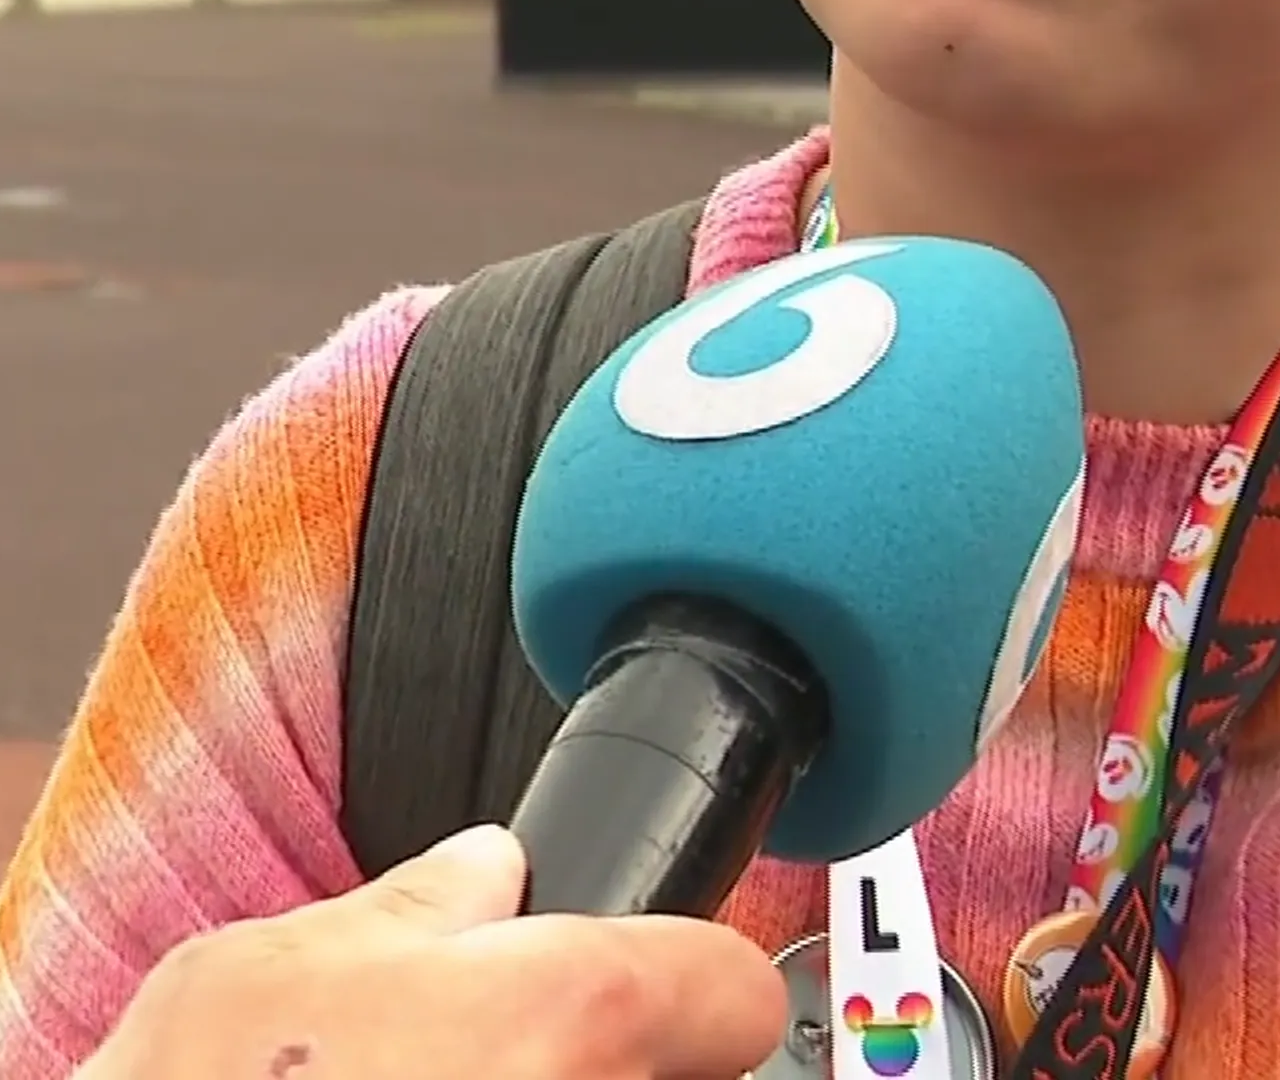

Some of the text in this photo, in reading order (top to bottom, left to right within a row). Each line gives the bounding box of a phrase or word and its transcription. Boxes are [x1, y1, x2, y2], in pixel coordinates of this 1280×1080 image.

[612, 244, 909, 441] 6
[860, 876, 901, 953] L
[1032, 842, 1168, 1080] ERS
